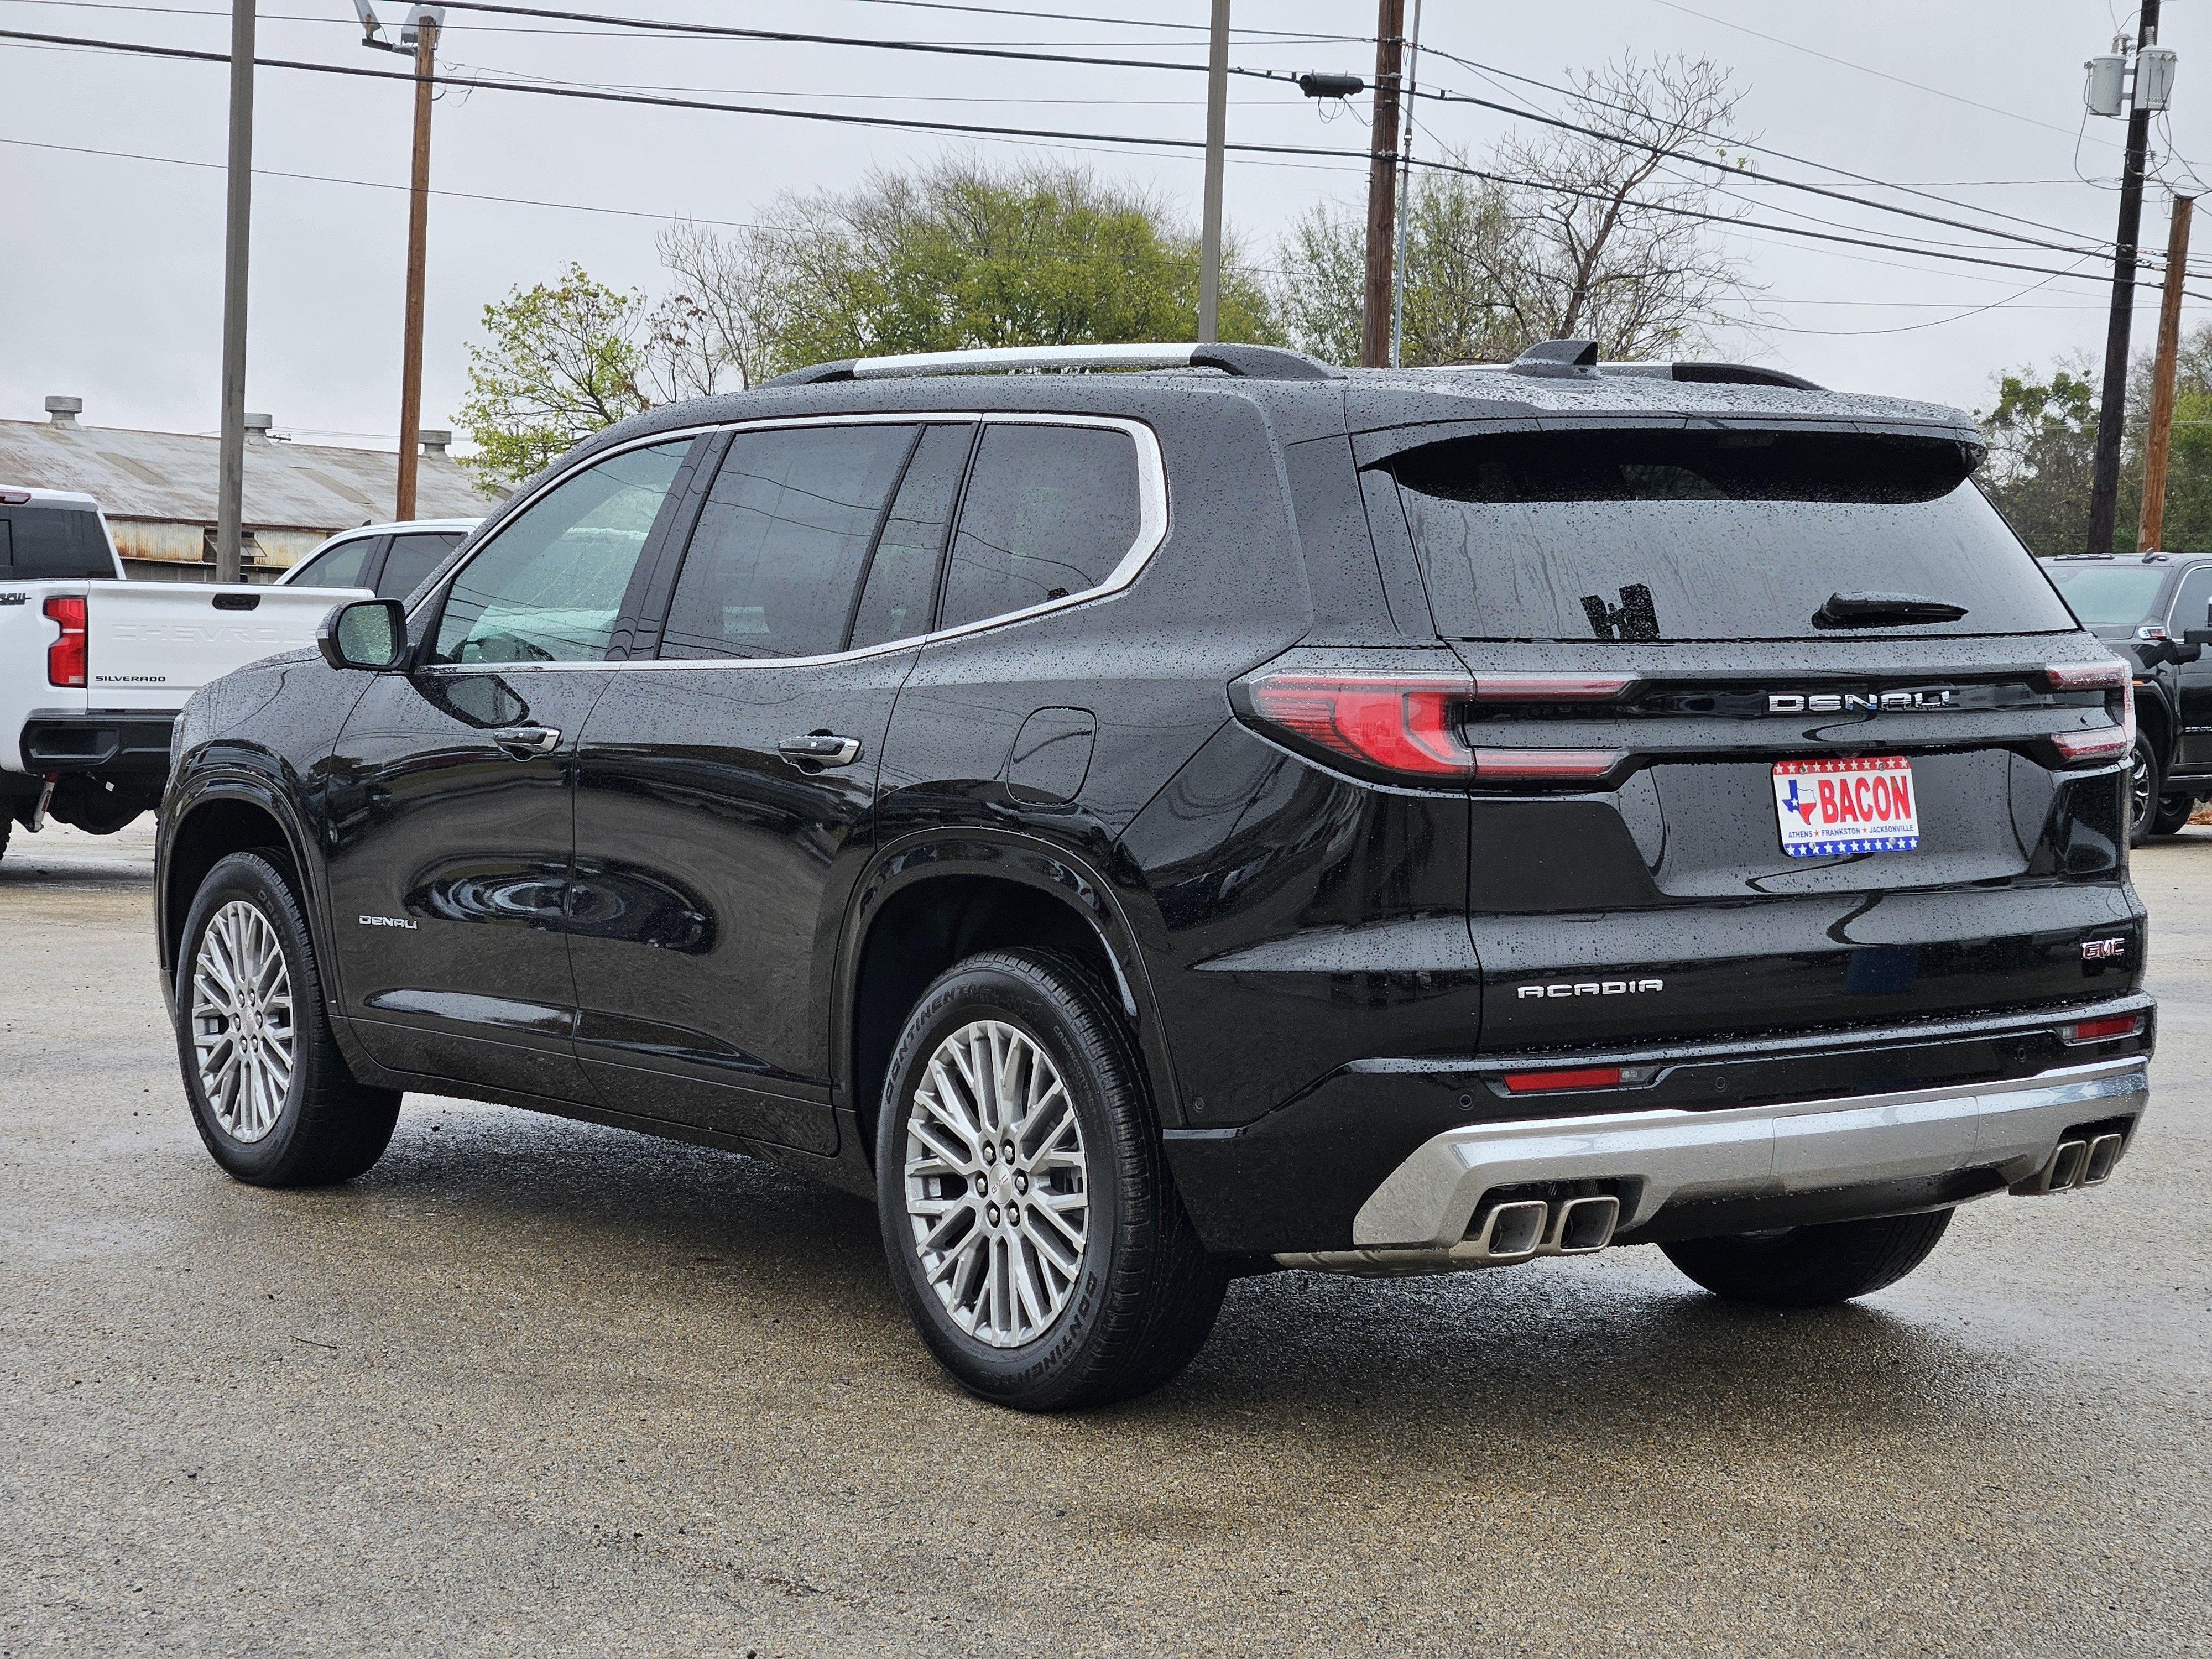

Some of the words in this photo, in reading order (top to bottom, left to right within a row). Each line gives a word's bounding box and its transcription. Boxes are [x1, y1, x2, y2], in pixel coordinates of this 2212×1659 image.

[112, 624, 317, 643] CHEVROLE
[1768, 691, 1950, 712] DENALI
[1818, 775, 1911, 824] BACON
[1788, 830, 1813, 839] ATHENS
[1822, 827, 1861, 837] FRANKSTON
[1870, 825, 1913, 834] JACKSONVILLE
[359, 915, 418, 930] DENALI
[2081, 937, 2125, 959] GMC
[1517, 979, 1663, 999] ACADIA
[992, 1173, 1008, 1194] GMC
